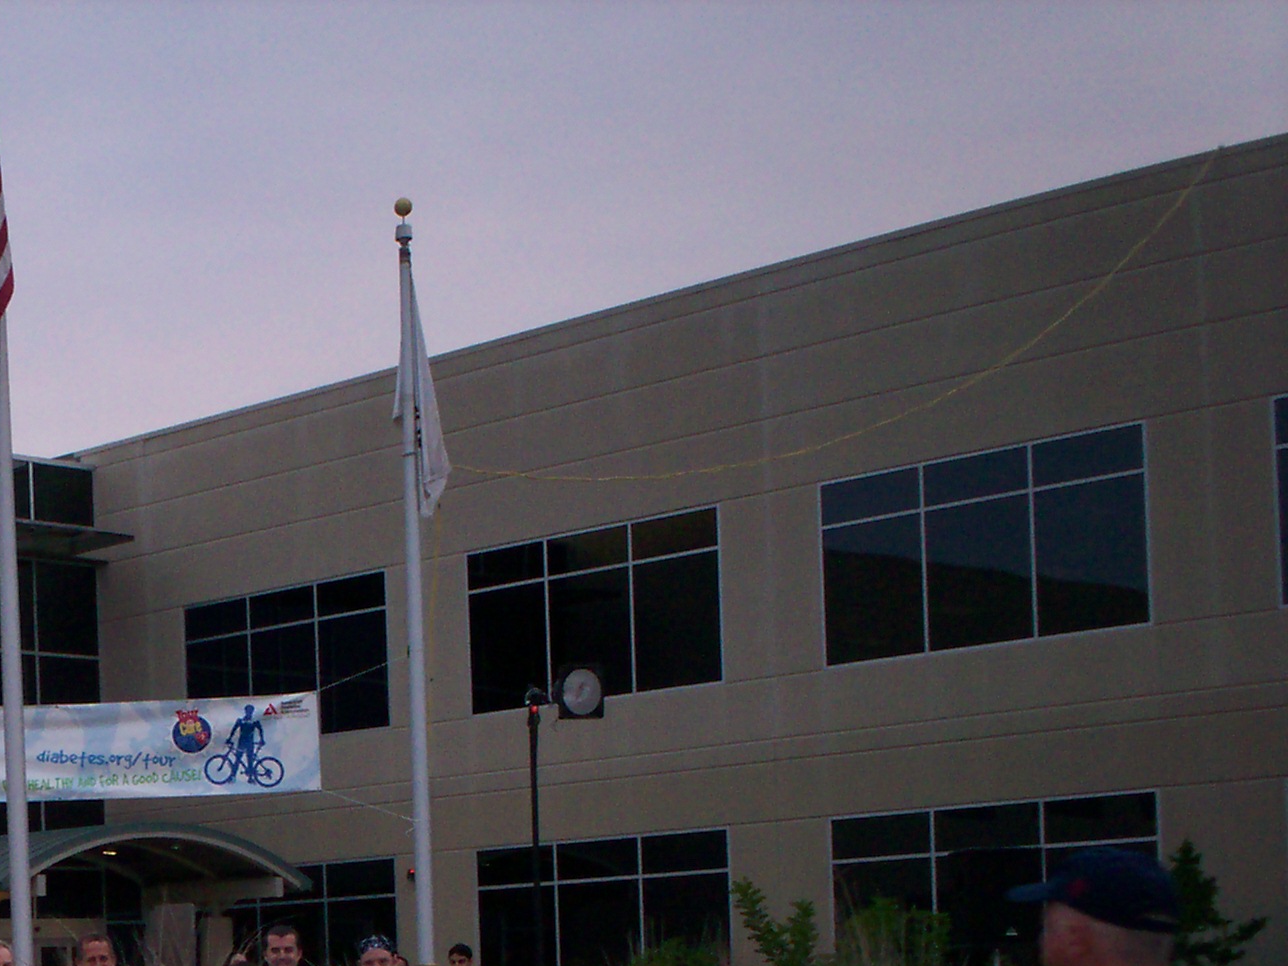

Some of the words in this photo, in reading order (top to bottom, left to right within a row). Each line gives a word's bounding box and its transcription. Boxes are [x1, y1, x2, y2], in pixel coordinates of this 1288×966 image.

[36, 749, 177, 770] diabetes.org/tour
[123, 773, 130, 786] A
[132, 771, 159, 785] GOOD
